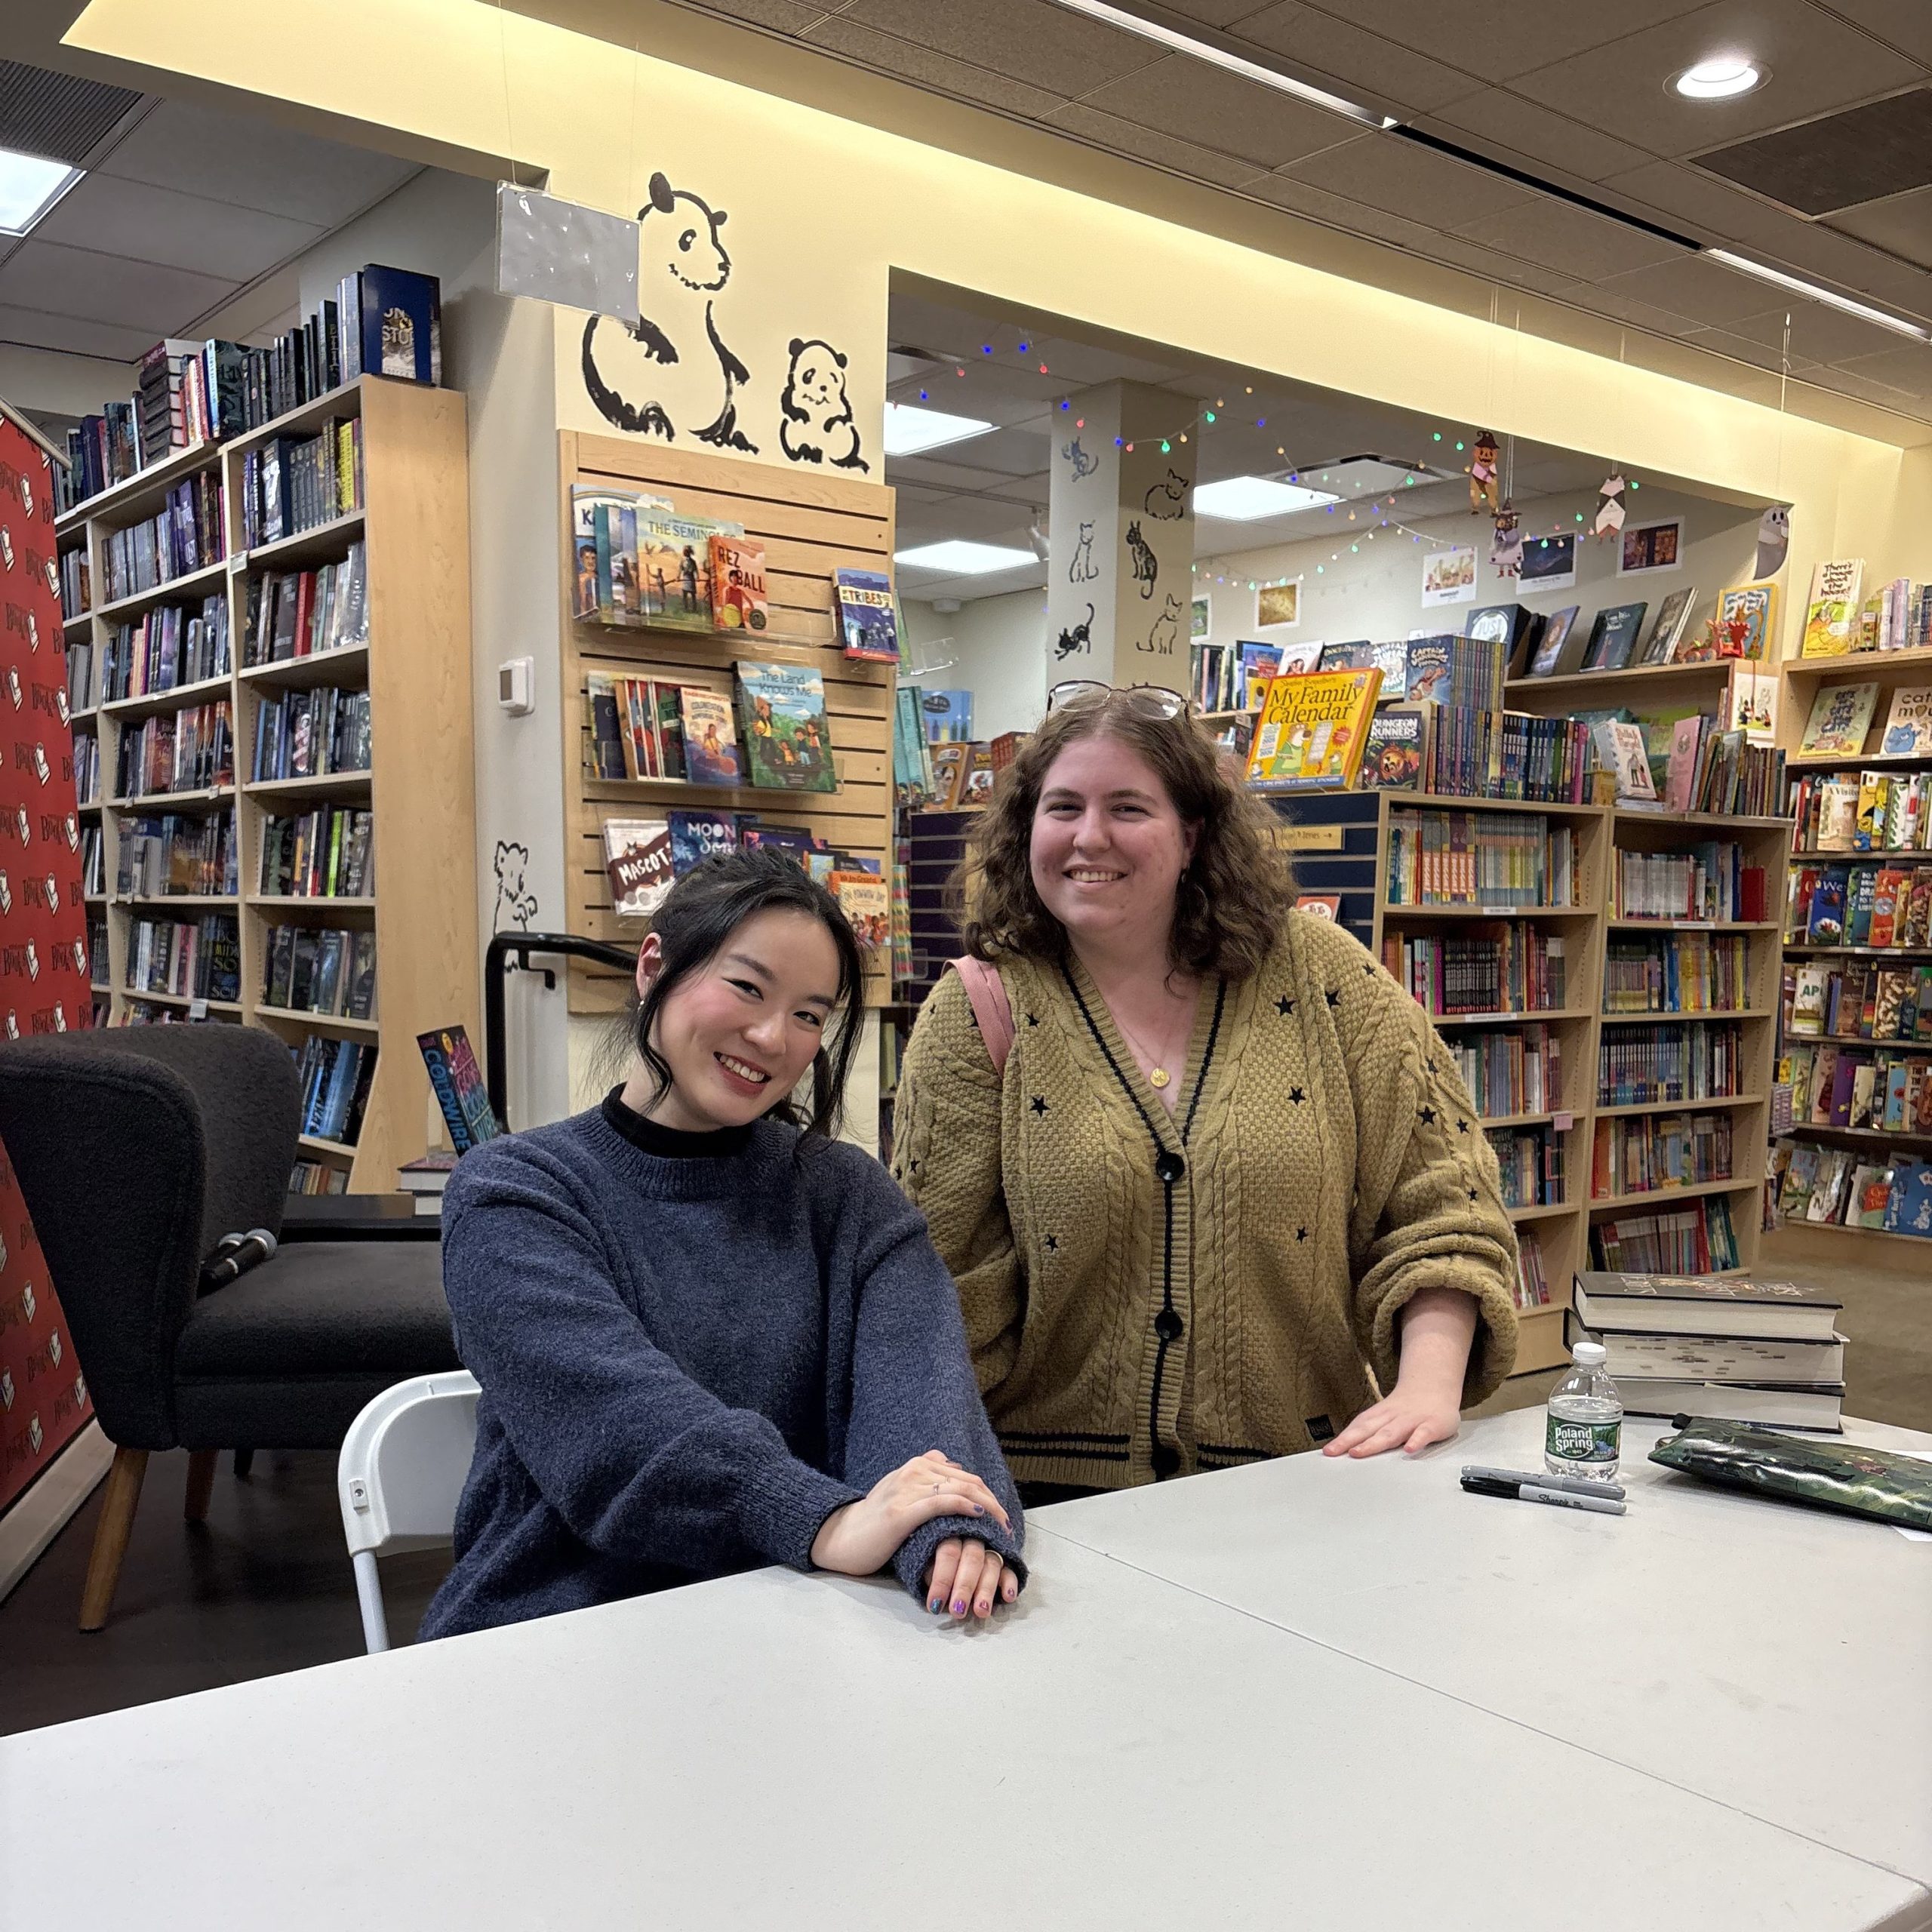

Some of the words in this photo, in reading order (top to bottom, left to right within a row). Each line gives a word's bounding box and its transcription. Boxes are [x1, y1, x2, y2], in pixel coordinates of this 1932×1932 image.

[648, 521, 671, 535] THE
[718, 546, 740, 568] REZ
[737, 569, 765, 594] BALL
[848, 590, 883, 605] TRIBES
[761, 672, 778, 681] The
[782, 672, 805, 685] Land
[760, 683, 795, 696] Knows
[797, 686, 812, 698] Me
[1269, 688, 1300, 709] My
[1299, 682, 1364, 706] Family
[1268, 703, 1352, 724] Calendar
[1372, 718, 1418, 729] DUNGEON
[1371, 727, 1418, 737] RUNNERS
[688, 822, 737, 838] MOON
[618, 848, 670, 886] MASCOT
[423, 1049, 472, 1151] COLDWIRE
[1555, 1426, 1592, 1440] Poland
[1555, 1438, 1593, 1452] Spring
[1539, 1494, 1569, 1506] Sharpie
